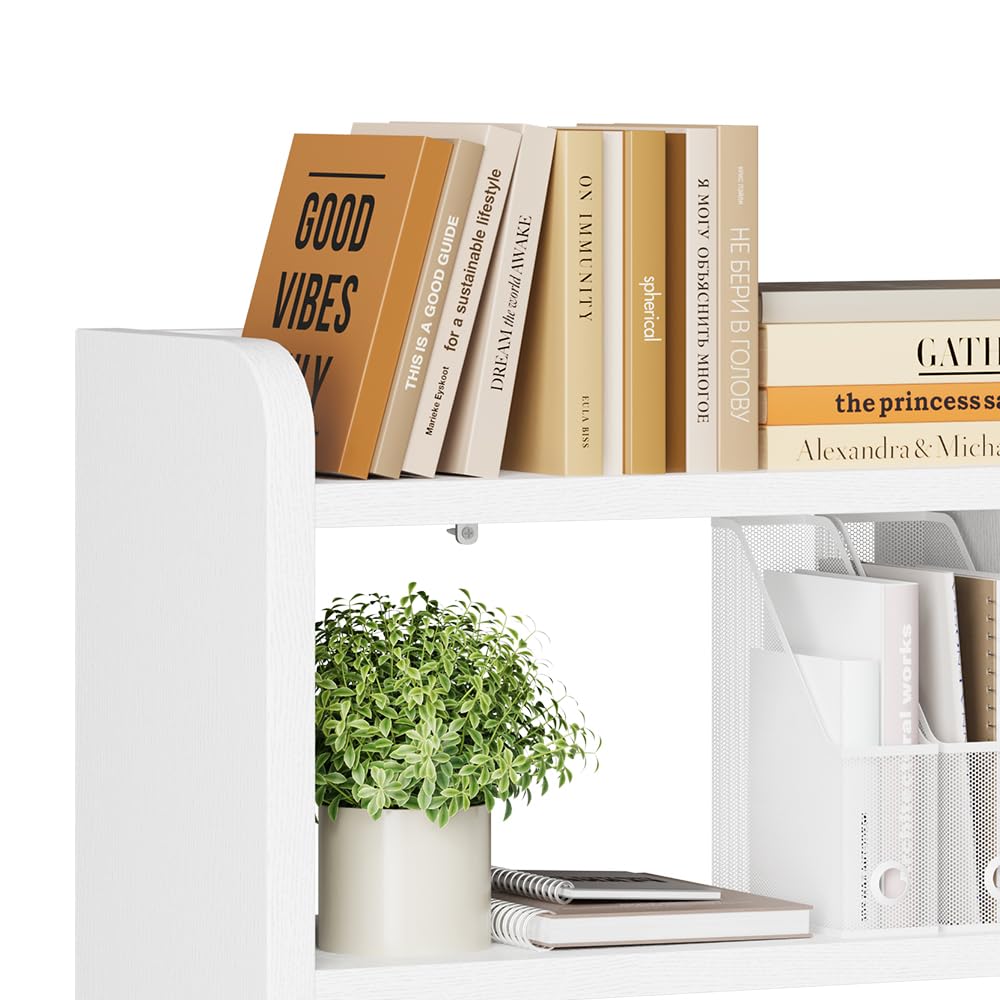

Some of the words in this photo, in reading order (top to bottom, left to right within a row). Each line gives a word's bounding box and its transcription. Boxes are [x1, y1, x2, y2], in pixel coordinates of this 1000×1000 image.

[476, 168, 502, 226] lifestyle
[578, 175, 593, 201] ON
[697, 178, 710, 188] Я
[295, 191, 375, 252] GOOD
[438, 215, 460, 266] GUIDE
[697, 193, 710, 240] МОГУ
[730, 227, 750, 253] НЕ
[511, 215, 532, 275] AWAKE
[578, 213, 593, 322] IMMUNITY
[425, 268, 445, 318] GOOD
[457, 229, 486, 313] sustainable
[508, 275, 522, 308] world
[730, 260, 750, 312] БЕРИ
[271, 271, 359, 334] VIBES
[502, 308, 516, 328] the
[639, 275, 662, 342] spherical
[697, 246, 710, 349] ОБЪЯСНИТЬ
[416, 336, 428, 353] IS
[421, 322, 432, 335] A
[444, 331, 459, 352] for
[453, 319, 463, 327] a
[730, 320, 750, 333] В
[405, 354, 424, 390] THIS
[490, 329, 513, 391] DREAM
[730, 340, 750, 423] ГОЛОВУ
[425, 402, 441, 436] Marieke
[434, 365, 450, 400] Eyskoot
[582, 395, 590, 423] EULA
[697, 353, 710, 424] МНОГОЕ
[835, 392, 875, 413] the
[878, 390, 981, 417] princess
[582, 427, 590, 449] BISS
[797, 436, 910, 462] Alexandra
[914, 438, 932, 458] &
[899, 623, 912, 705] works
